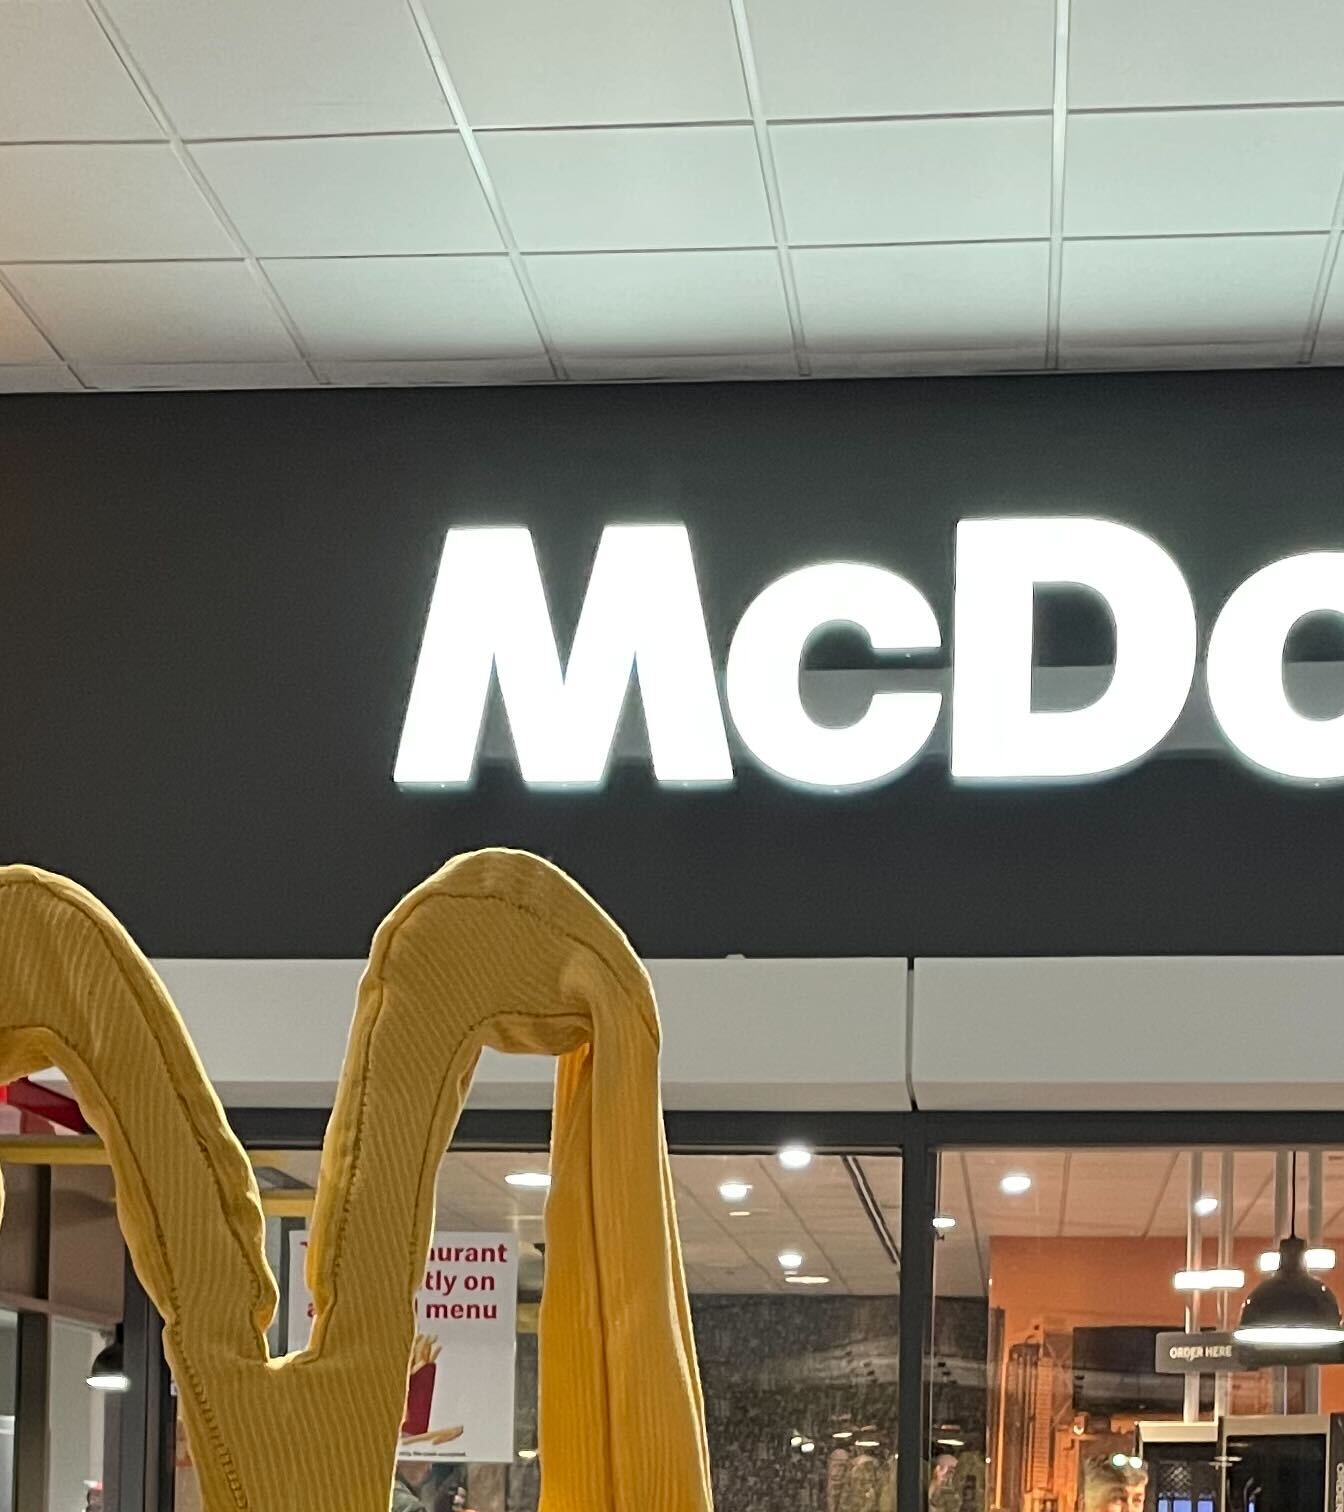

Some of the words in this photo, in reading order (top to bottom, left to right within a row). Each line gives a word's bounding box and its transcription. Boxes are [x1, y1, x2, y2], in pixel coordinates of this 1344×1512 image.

[463, 1274, 496, 1292] on
[425, 1302, 498, 1320] menu
[1168, 1346, 1204, 1361] ORDER
[1205, 1345, 1233, 1358] HERE
